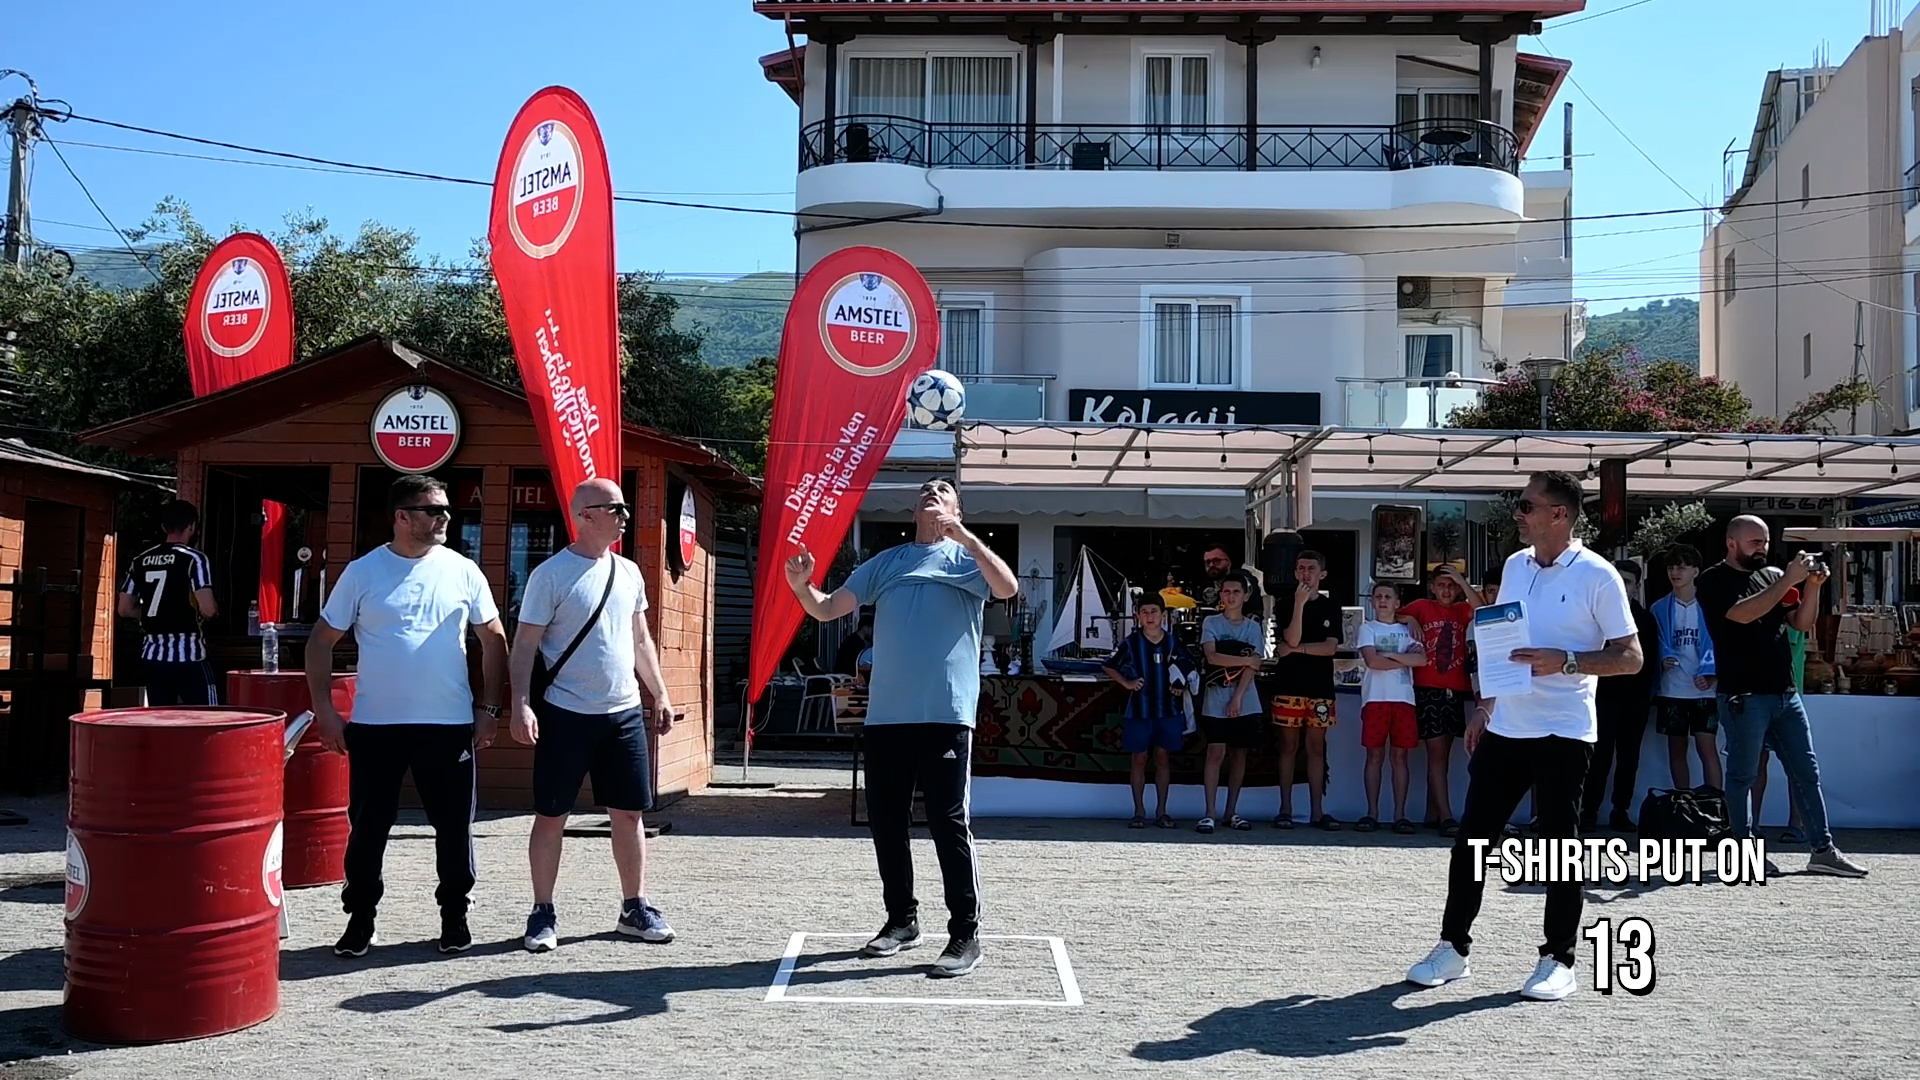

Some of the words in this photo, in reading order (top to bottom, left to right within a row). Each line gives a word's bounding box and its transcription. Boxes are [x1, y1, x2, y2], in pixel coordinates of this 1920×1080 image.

[834, 304, 902, 327] AMSTEL
[850, 329, 885, 345] BEER
[383, 415, 449, 430] AMSTEL
[398, 436, 431, 447] BEER
[787, 463, 836, 546] momente
[825, 445, 846, 464] ia
[839, 411, 866, 445] vlen
[819, 495, 838, 517] të
[830, 424, 879, 497] rijetohen
[469, 486, 546, 504] ATEL
[784, 472, 816, 512] Disa
[142, 554, 175, 566] CHIESA
[145, 569, 167, 617] 7
